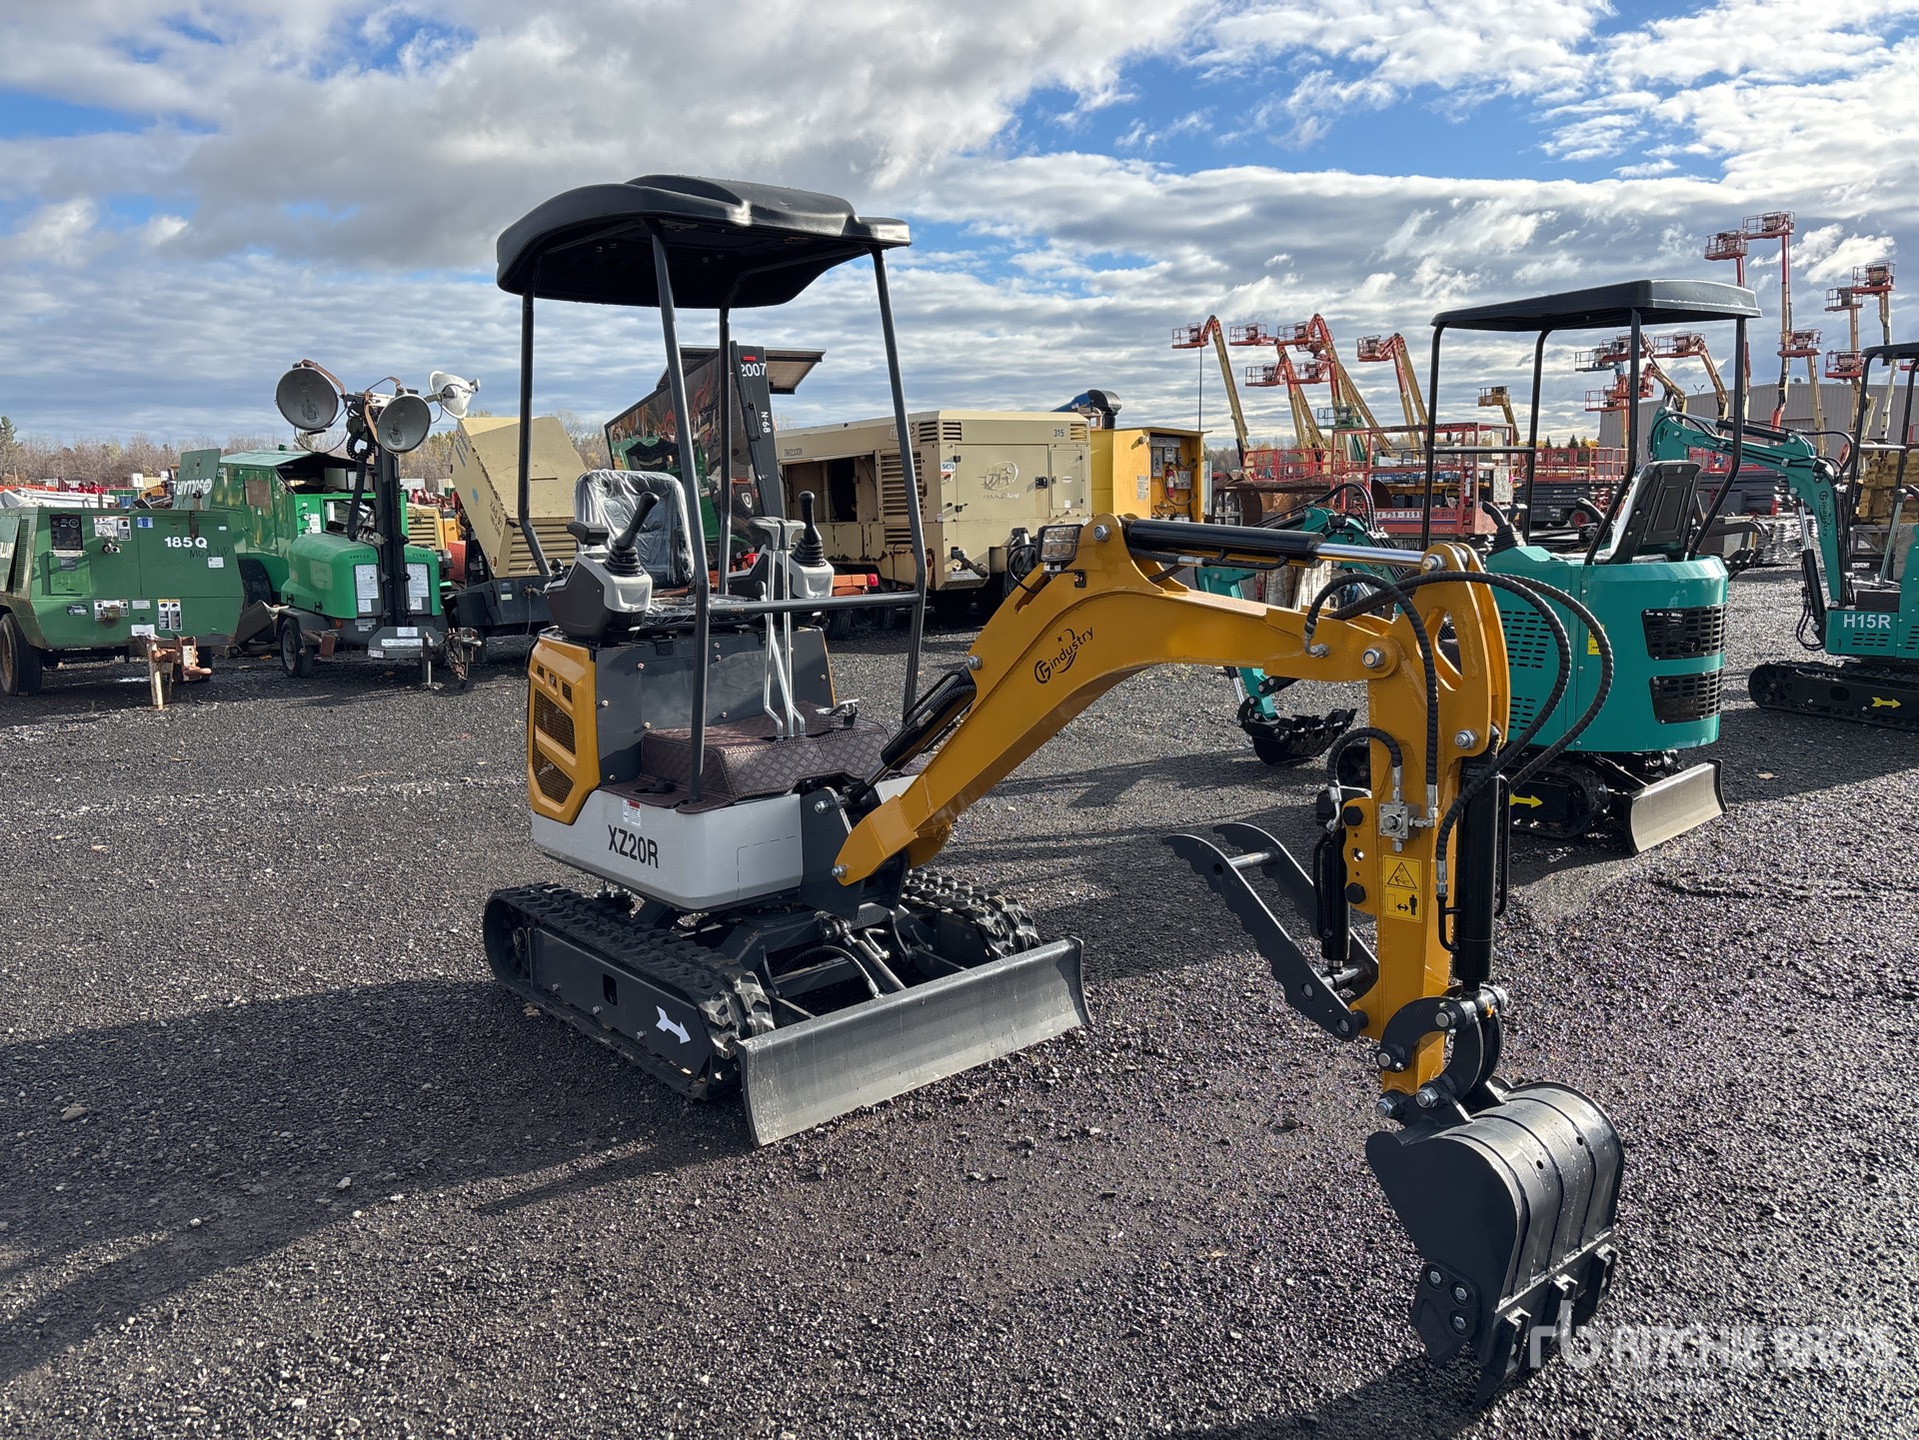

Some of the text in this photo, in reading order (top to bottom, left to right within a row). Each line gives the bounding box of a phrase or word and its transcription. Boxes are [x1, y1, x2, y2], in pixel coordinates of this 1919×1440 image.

[741, 363, 766, 377] 2007
[761, 411, 771, 433] N-68
[1054, 429, 1064, 437] 315
[1843, 614, 1891, 629] H15R
[607, 823, 659, 869] XZ20R
